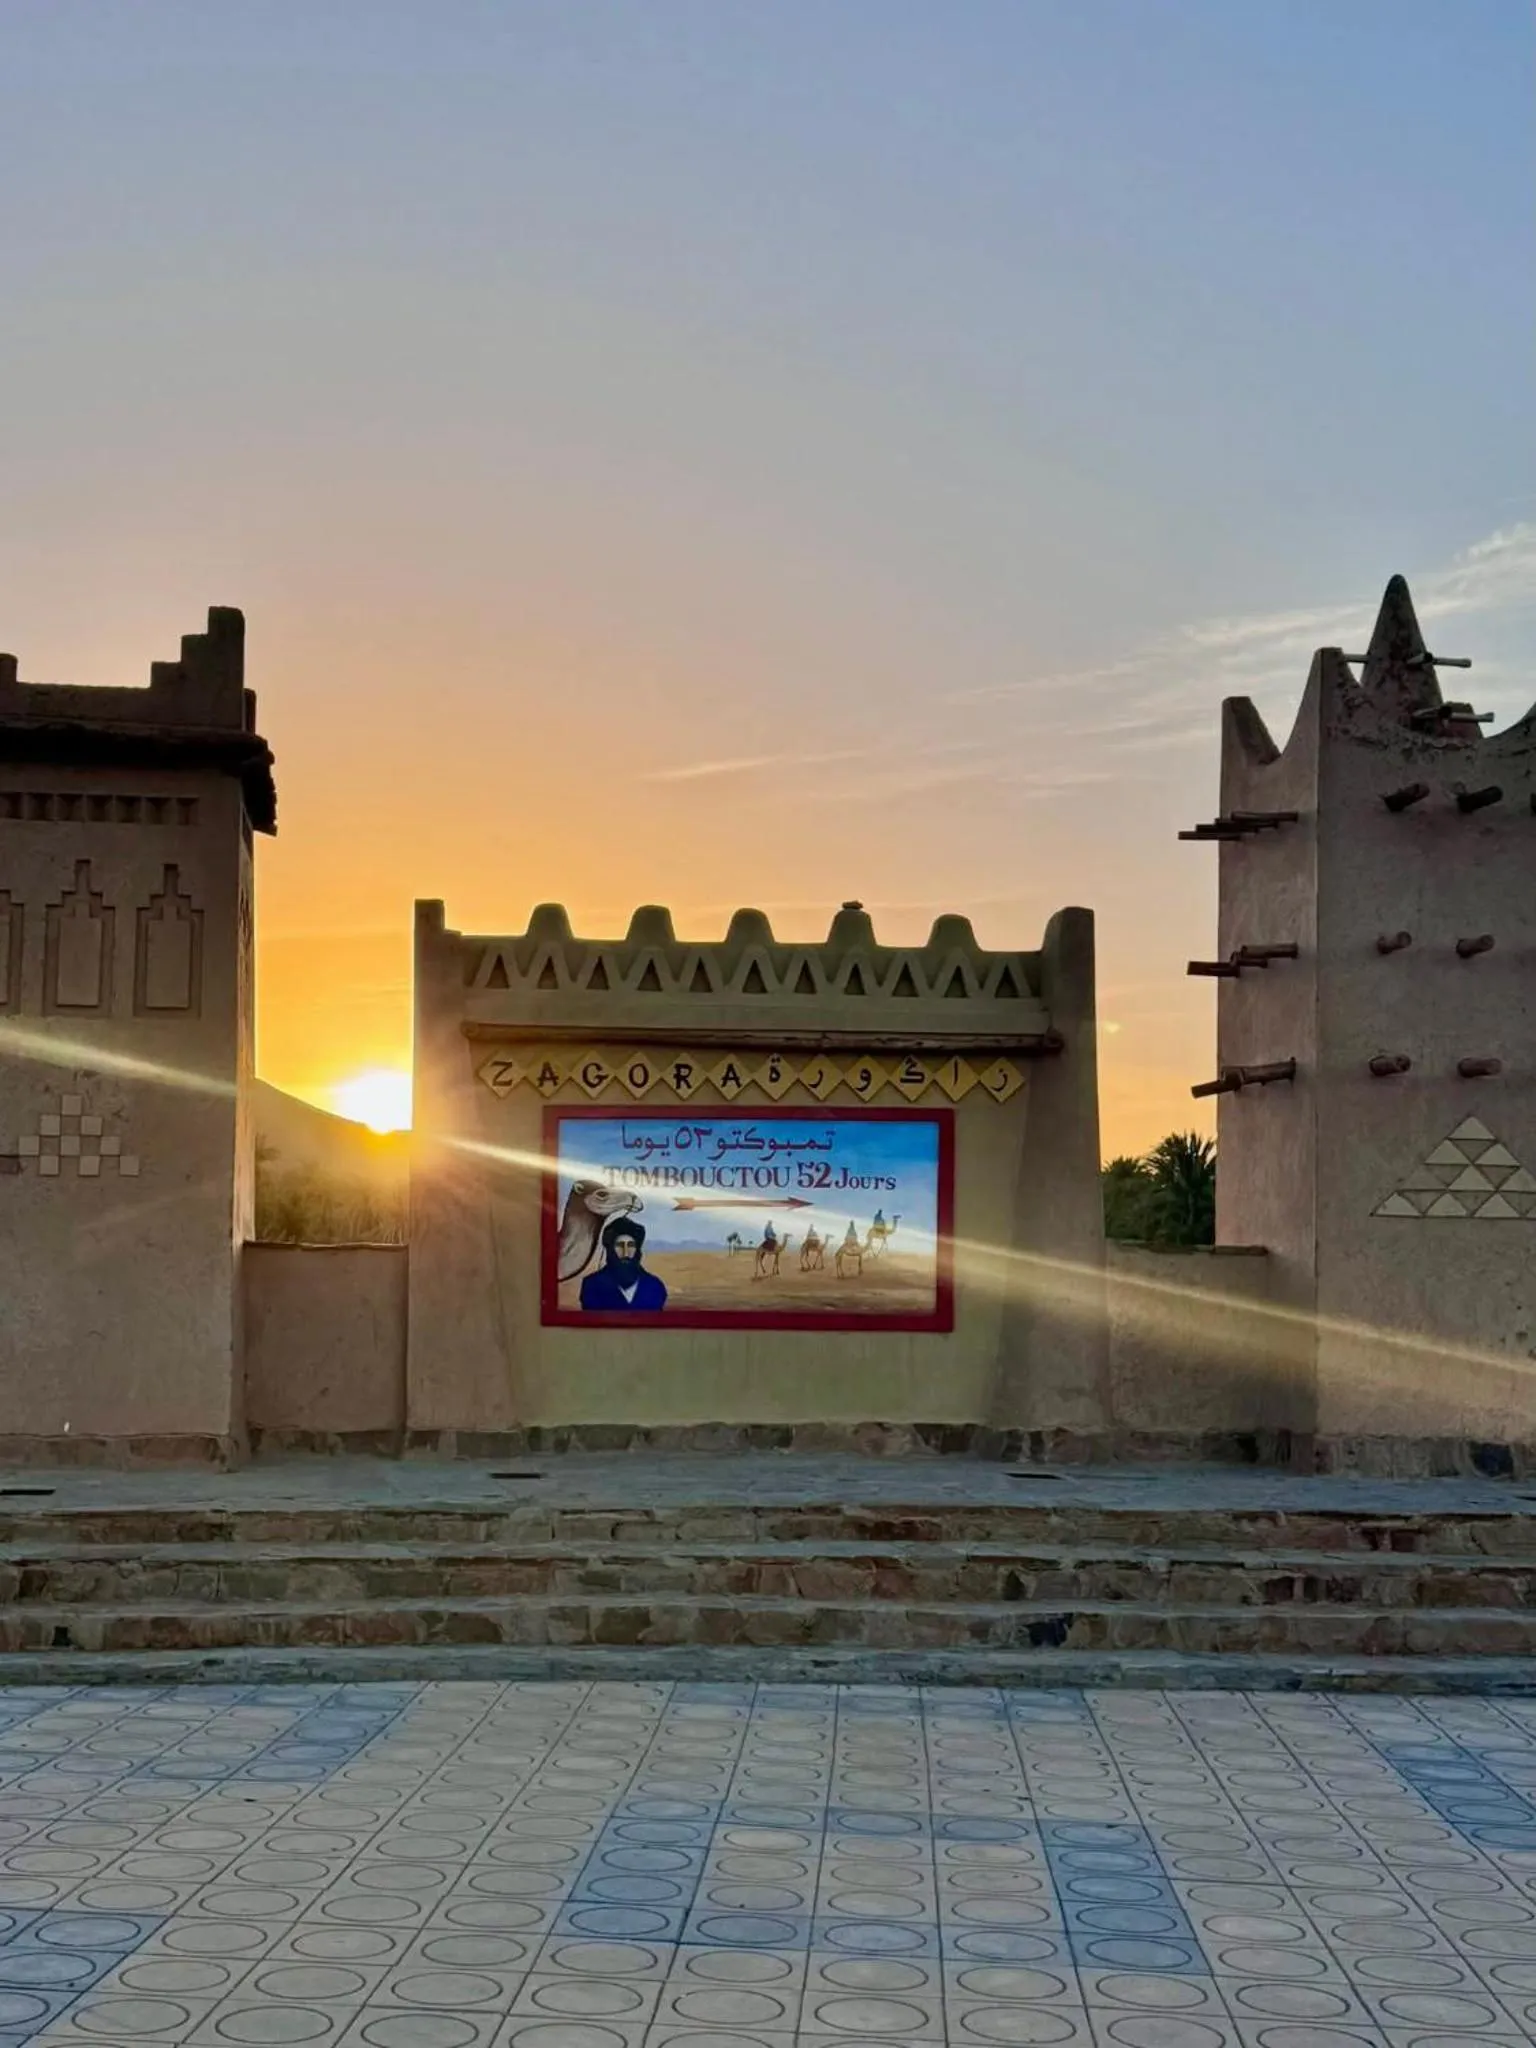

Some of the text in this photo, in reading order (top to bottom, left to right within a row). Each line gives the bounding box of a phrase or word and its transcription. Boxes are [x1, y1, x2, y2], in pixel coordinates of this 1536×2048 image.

[491, 1061, 741, 1089] ZAGORA
[621, 1124, 671, 1161] يوما
[707, 1127, 837, 1161] تمبوكتو
[604, 1166, 791, 1189] TOMBOUCTOU
[797, 1161, 831, 1189] 52
